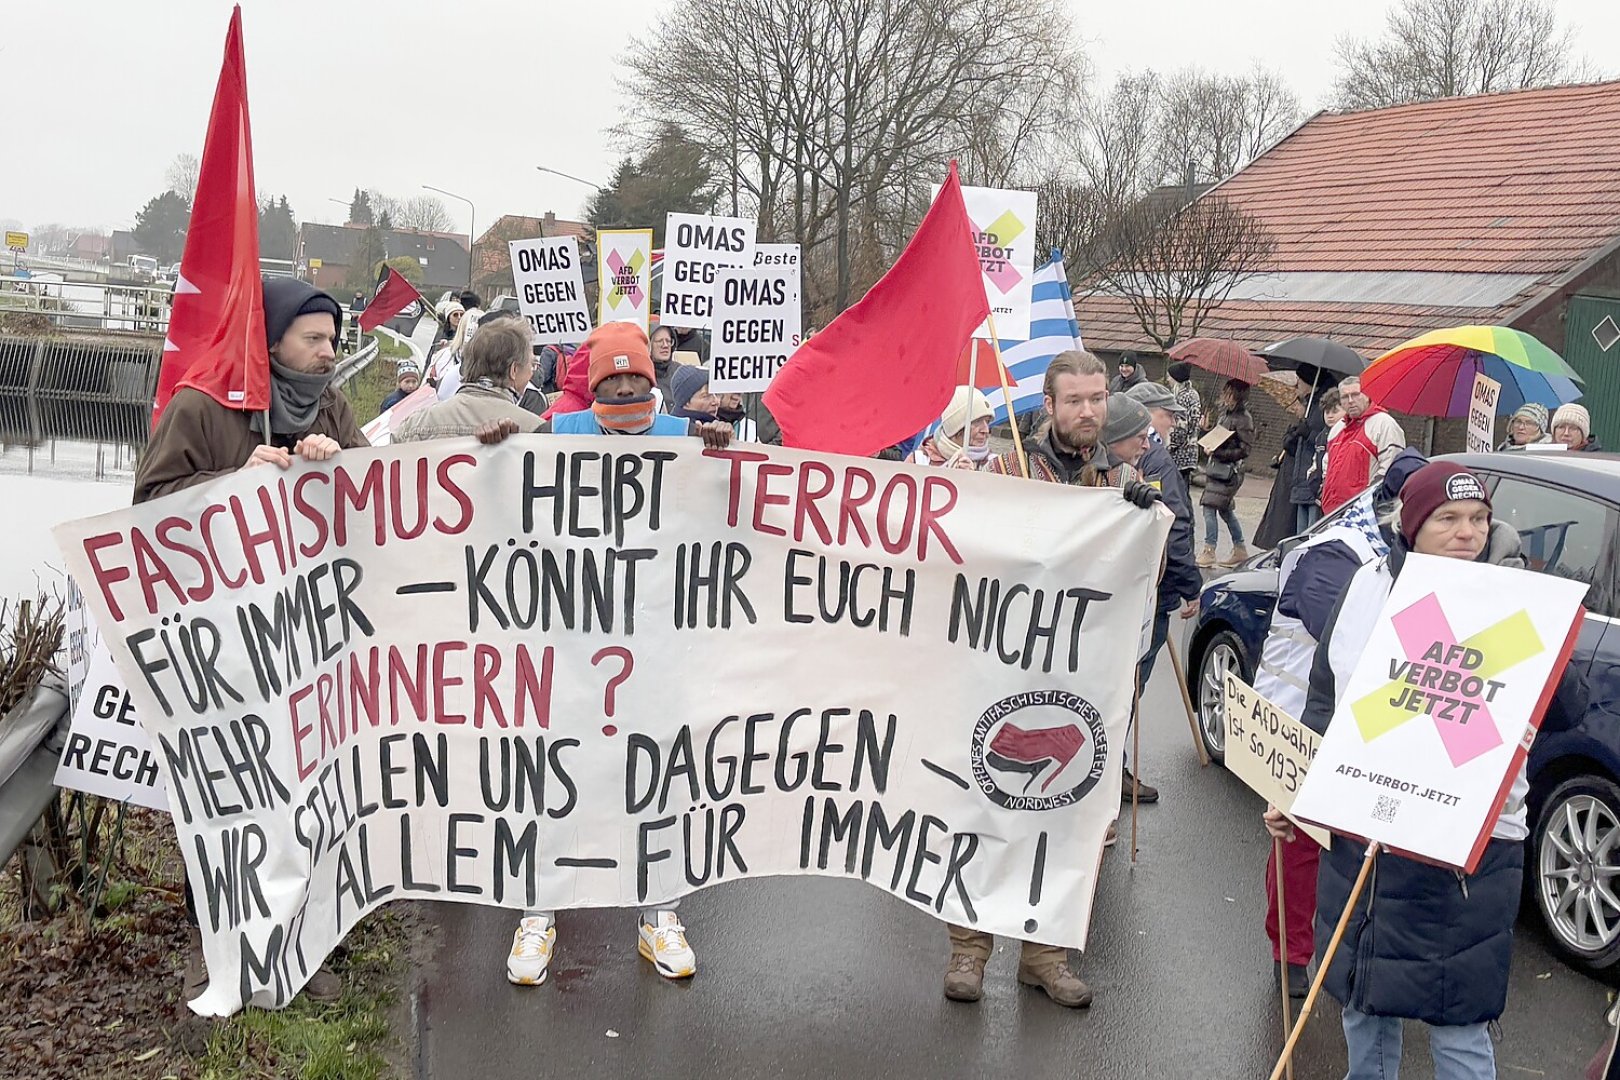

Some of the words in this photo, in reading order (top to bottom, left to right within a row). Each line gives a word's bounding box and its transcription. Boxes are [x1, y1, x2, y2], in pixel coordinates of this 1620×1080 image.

[677, 223, 745, 252] OMAS
[518, 245, 571, 273] OMAS
[619, 266, 633, 276] AFD
[524, 280, 577, 304] GEGEN
[611, 275, 640, 286] VERBOT
[615, 285, 637, 296] JETZT
[725, 279, 786, 307] OMAS
[722, 319, 784, 344] GEGEN
[1474, 381, 1496, 408] OMAS
[1471, 408, 1491, 434] GEGEN
[84, 454, 477, 622] FASCHISMUS
[702, 449, 964, 564] TERROR
[127, 613, 244, 717] FÜR
[238, 558, 376, 701] IMMER
[465, 538, 657, 635] KÖNNT
[675, 541, 757, 630] IHR
[785, 549, 915, 636] EUCH
[948, 573, 1113, 673] NICHT
[1421, 641, 1484, 669] AFD
[1227, 677, 1247, 709] Die
[1388, 659, 1506, 703] VERBOT
[93, 684, 137, 727] GE
[1389, 687, 1481, 726] JETZT
[158, 714, 291, 824] MEHR
[287, 641, 556, 783] ERINNERN
[1228, 708, 1245, 742] ist
[1266, 748, 1308, 793] 193
[1335, 764, 1462, 808] AFD-VERBOT.JETZT
[1004, 791, 1077, 811] NORDWEST
[194, 823, 272, 933] WIR
[295, 732, 449, 863] STELLEN
[479, 737, 580, 818] UNS
[626, 706, 897, 814] DAGEGEN
[336, 813, 537, 935] ALLEM
[636, 803, 748, 902] FÜR
[800, 795, 978, 924] IMMER
